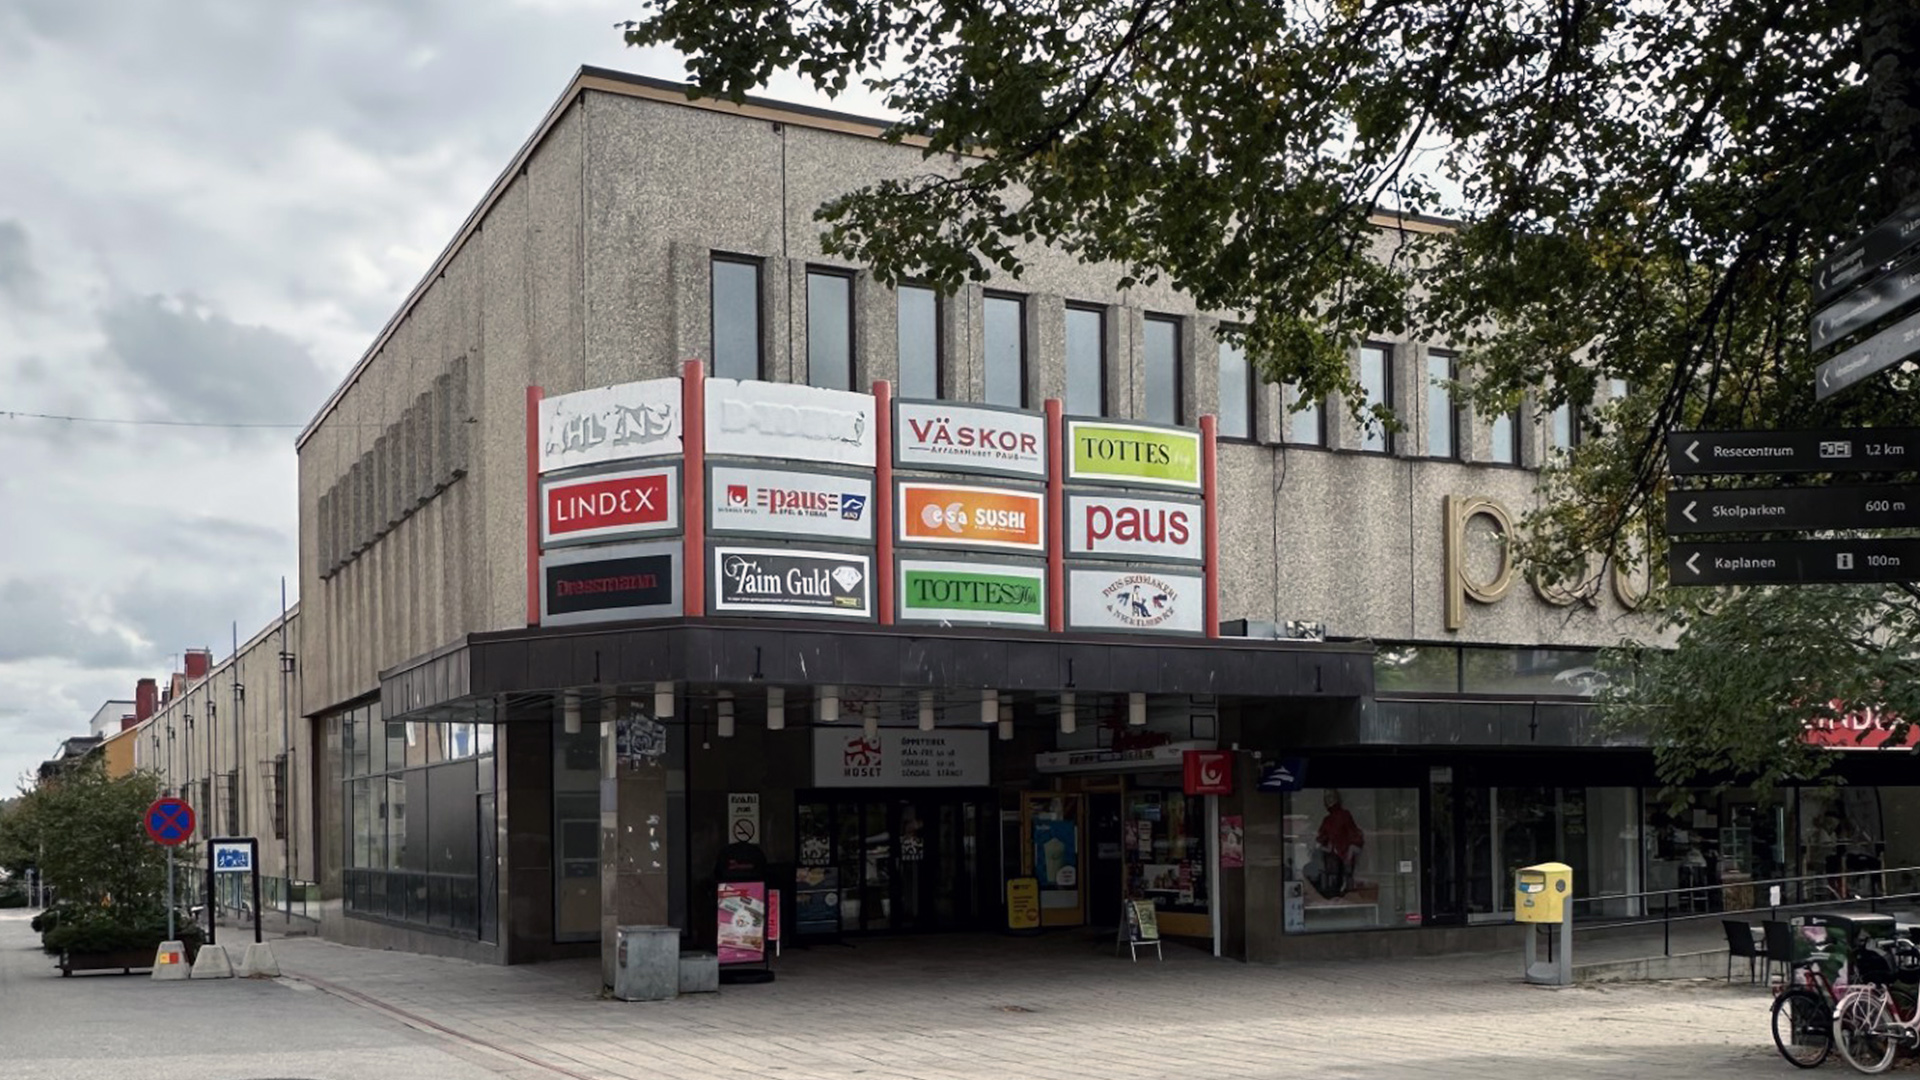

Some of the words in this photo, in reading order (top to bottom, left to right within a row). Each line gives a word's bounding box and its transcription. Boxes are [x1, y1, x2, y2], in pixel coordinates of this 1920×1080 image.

[908, 417, 1038, 454] VÄSKOR
[1081, 438, 1170, 465] TOTTES
[1713, 445, 1794, 457] Resecentrum
[1865, 443, 1881, 456] 1,2
[1884, 443, 1905, 456] km
[557, 487, 655, 521] LINDEX
[769, 488, 828, 514] paus
[1712, 504, 1785, 518] Skolparken
[1865, 500, 1889, 512] 600
[1893, 502, 1906, 511] m
[975, 508, 1026, 529] SUSHI
[1086, 505, 1189, 550] paus
[724, 555, 782, 594] Taim
[787, 567, 832, 597] Guld
[1714, 557, 1776, 571] Kaplanen
[556, 573, 658, 597] Dressmann
[913, 579, 1016, 604] TOTTES
